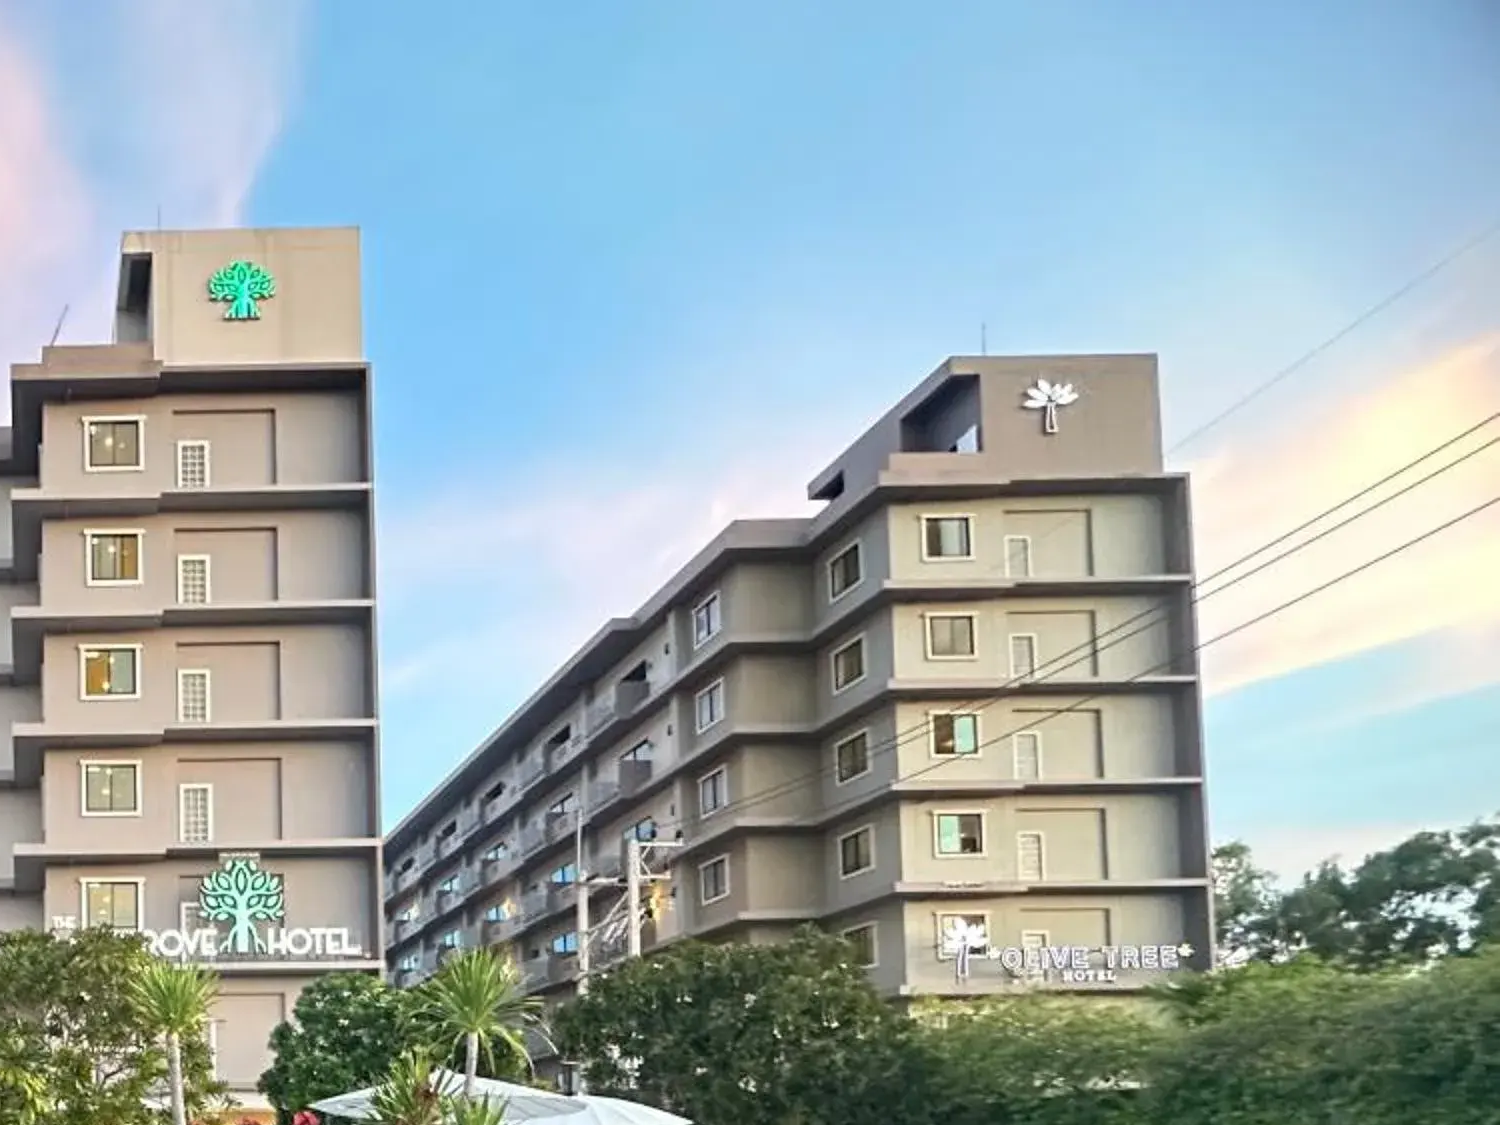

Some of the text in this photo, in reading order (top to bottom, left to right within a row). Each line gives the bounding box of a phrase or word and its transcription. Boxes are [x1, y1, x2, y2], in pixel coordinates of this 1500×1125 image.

[268, 927, 362, 955] HOTEL
[1001, 945, 1180, 970] OLIVE TREE
[1063, 969, 1117, 982] HOTEL
